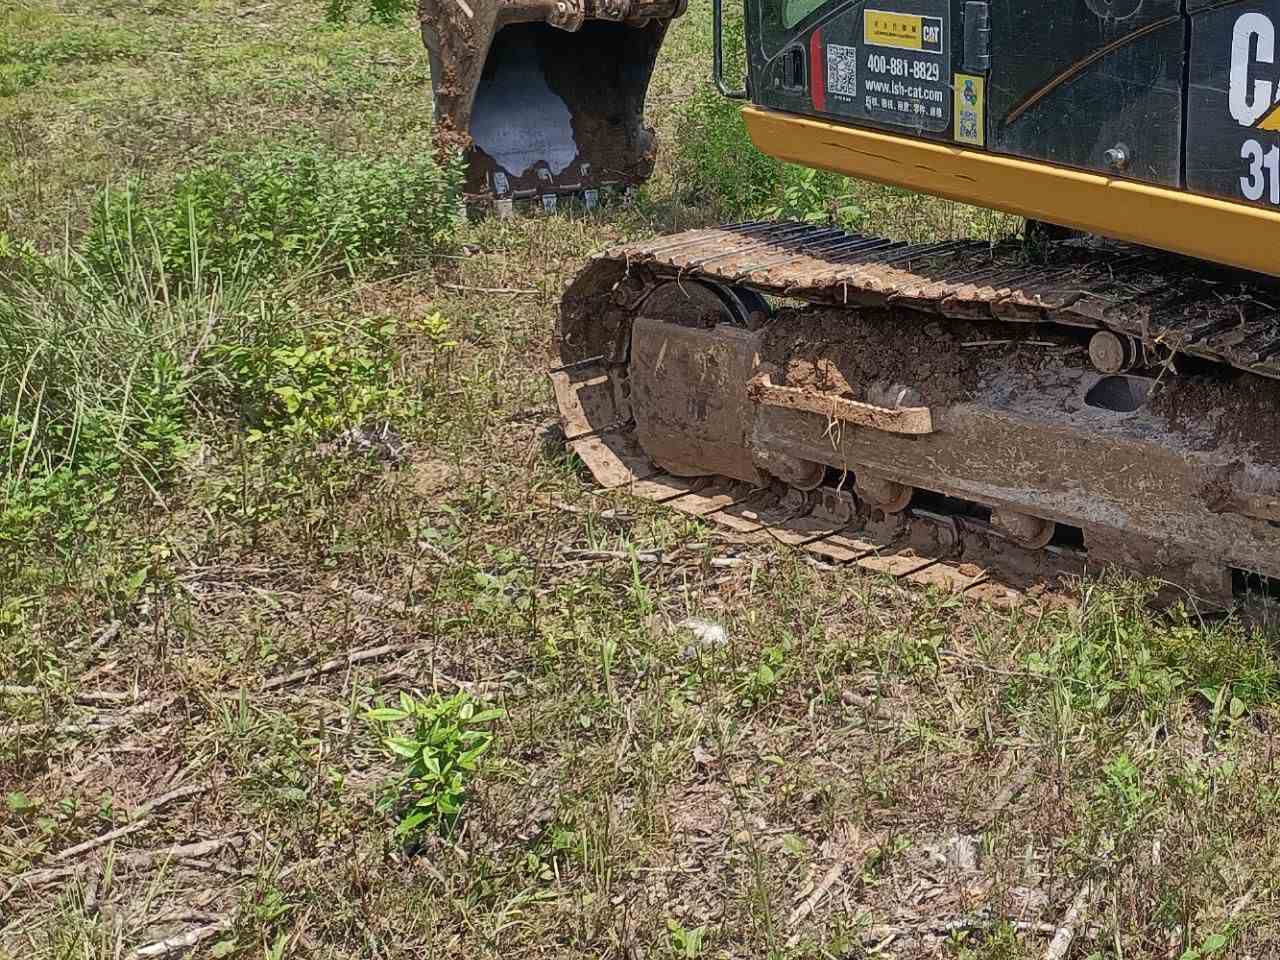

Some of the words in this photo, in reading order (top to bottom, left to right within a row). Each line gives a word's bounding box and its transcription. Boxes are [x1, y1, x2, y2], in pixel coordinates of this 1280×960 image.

[923, 25, 940, 43] CAT
[867, 53, 939, 82] 400-881-8829
[865, 79, 943, 103] www.lsh-cat.com
